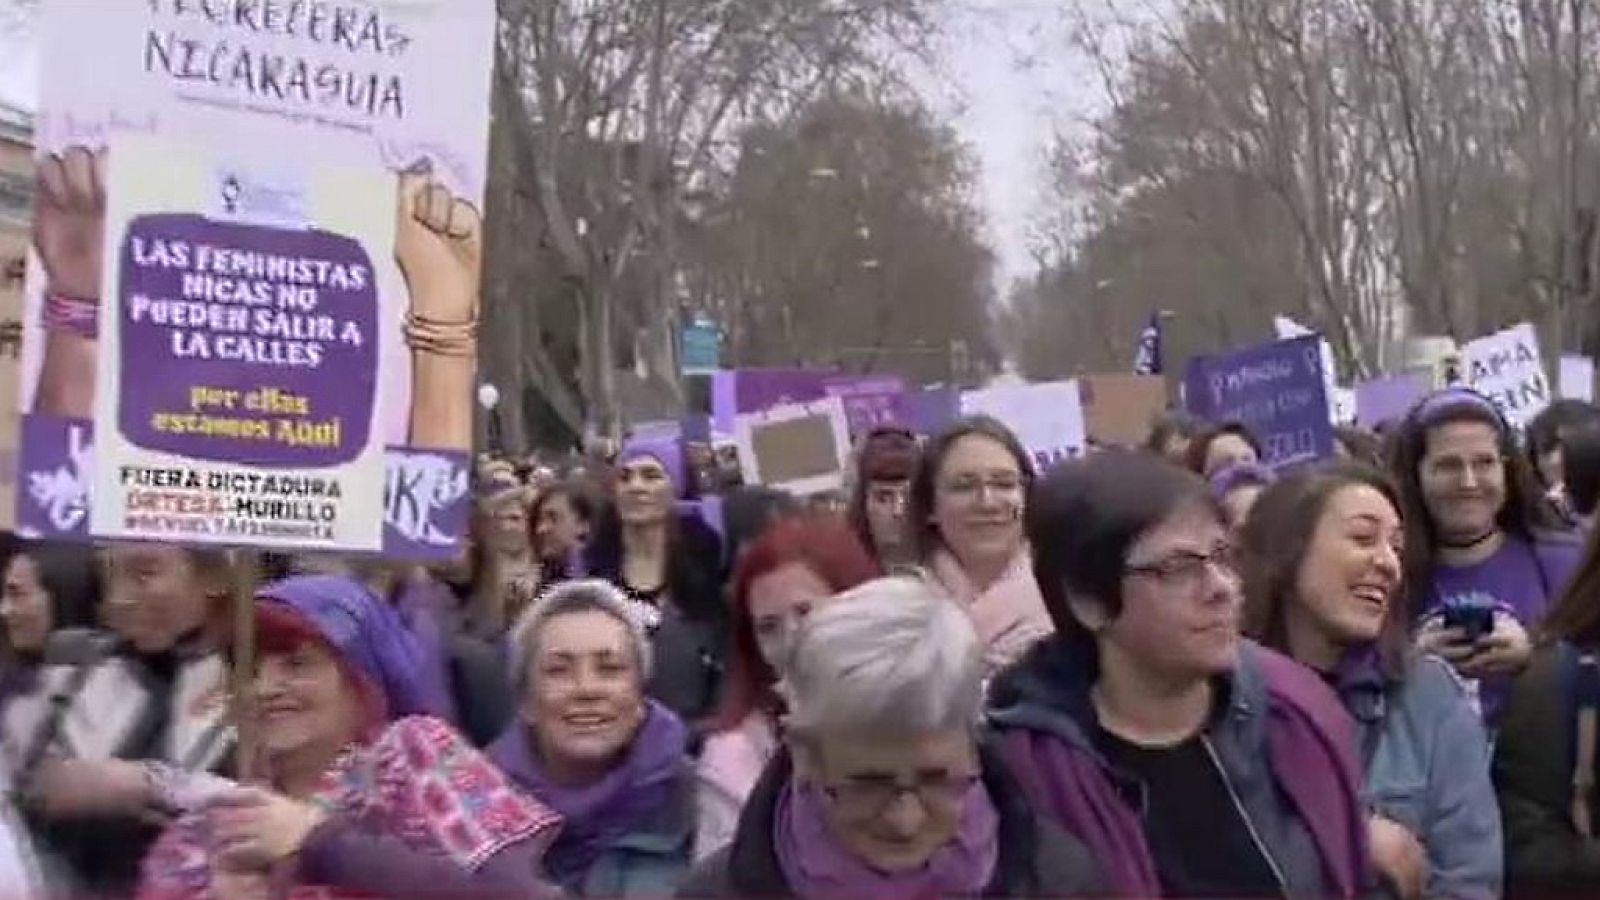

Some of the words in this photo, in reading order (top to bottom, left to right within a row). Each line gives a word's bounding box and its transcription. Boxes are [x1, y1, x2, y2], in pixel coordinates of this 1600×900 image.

[131, 237, 190, 268] LAS
[194, 246, 367, 292] FEMINISTAS
[182, 273, 272, 305] NICAS
[277, 283, 318, 312] NO
[129, 295, 249, 333] PUEDEN
[253, 308, 335, 341] SALIR
[340, 321, 362, 347] A
[171, 331, 211, 359] LA
[215, 336, 322, 368] CALLES
[119, 466, 202, 489] FUERA
[206, 470, 342, 499] DICTADURA
